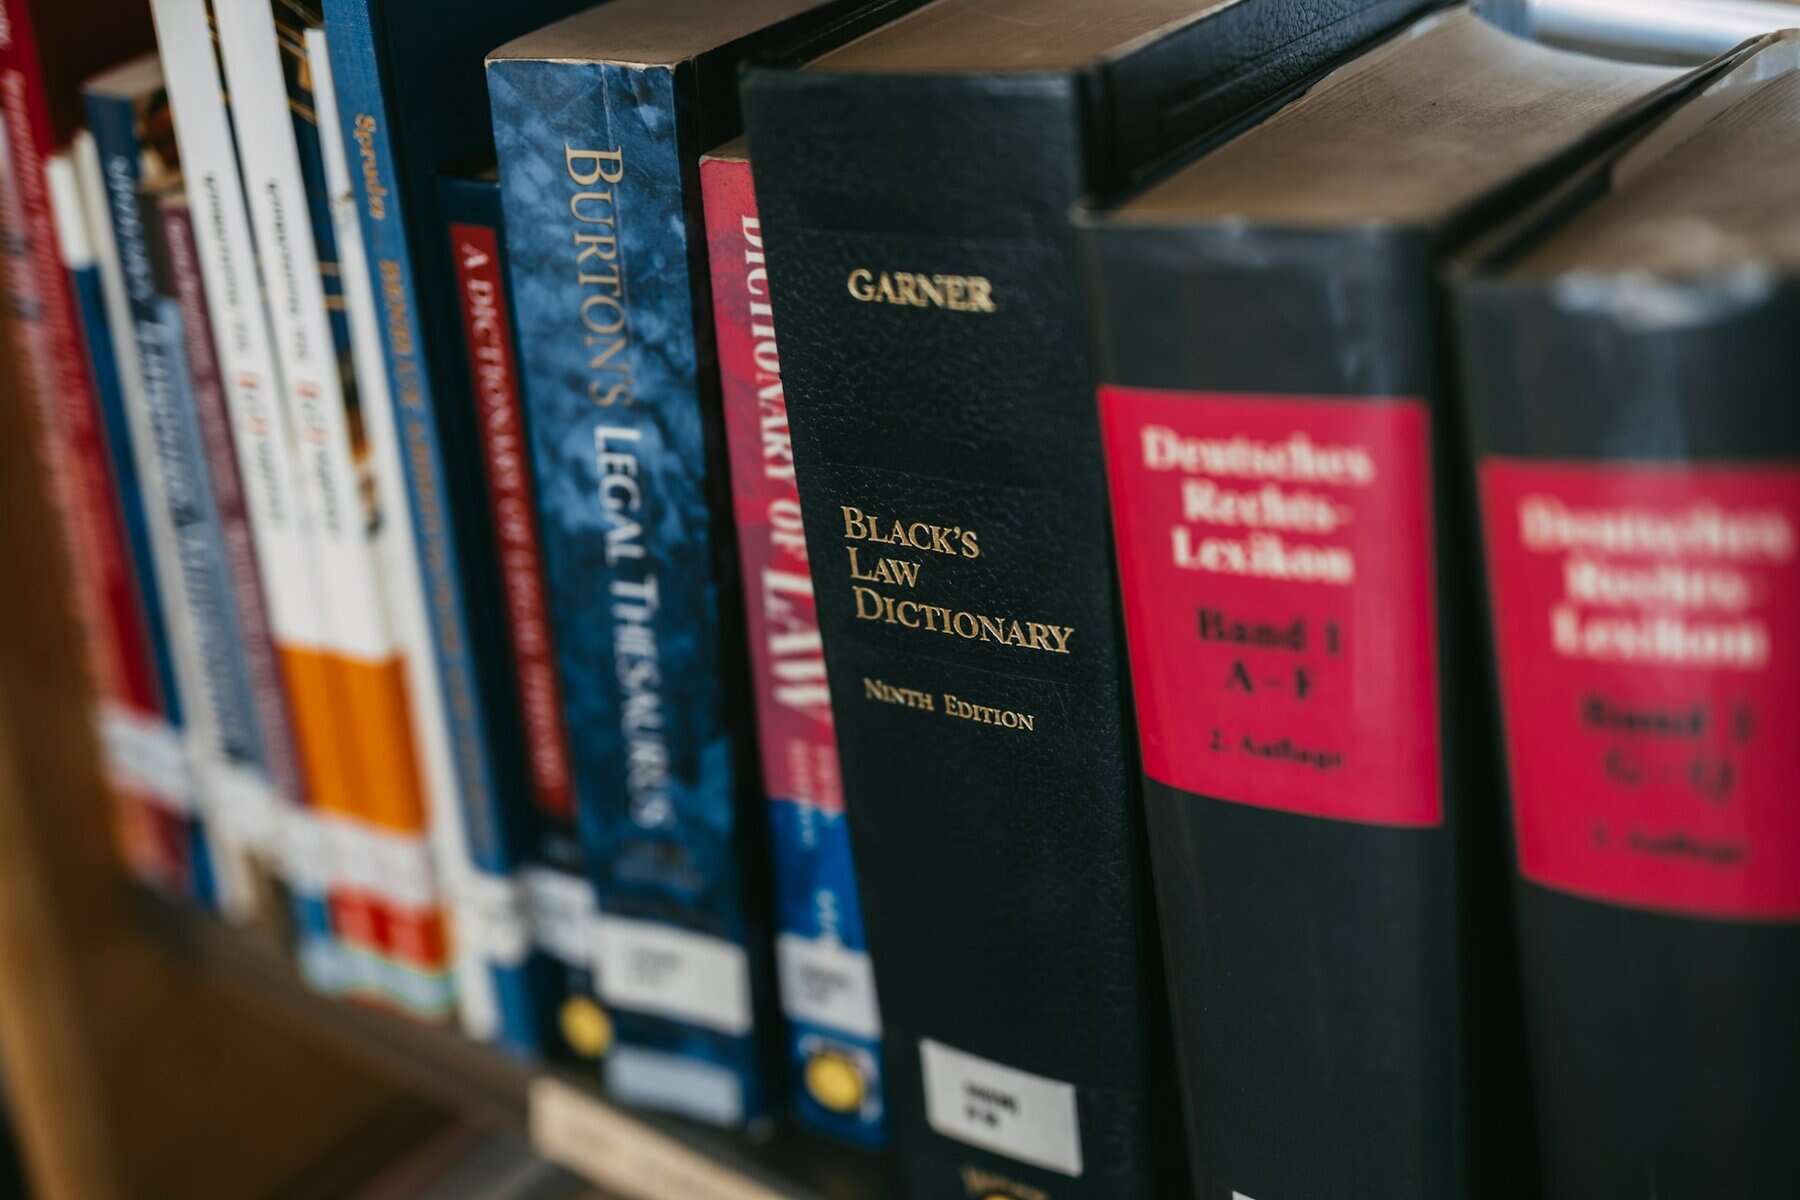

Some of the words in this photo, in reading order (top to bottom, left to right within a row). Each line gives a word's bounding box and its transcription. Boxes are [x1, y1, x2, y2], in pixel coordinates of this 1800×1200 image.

[462, 242, 489, 268] A
[563, 143, 635, 408] BURTON'S
[847, 268, 997, 313] GARNER
[1140, 424, 1377, 487] Deutsches
[594, 424, 645, 566] LEGAL
[840, 504, 981, 559] BLACK'S
[1172, 525, 1356, 585] Lexikon
[845, 546, 921, 588] LAW
[851, 585, 1074, 655] DICTIONARY
[1197, 608, 1307, 651] Band
[609, 573, 675, 831] THESAURUS
[863, 677, 935, 712] NINTH
[943, 693, 1036, 731] EDITION
[1224, 658, 1254, 695] A
